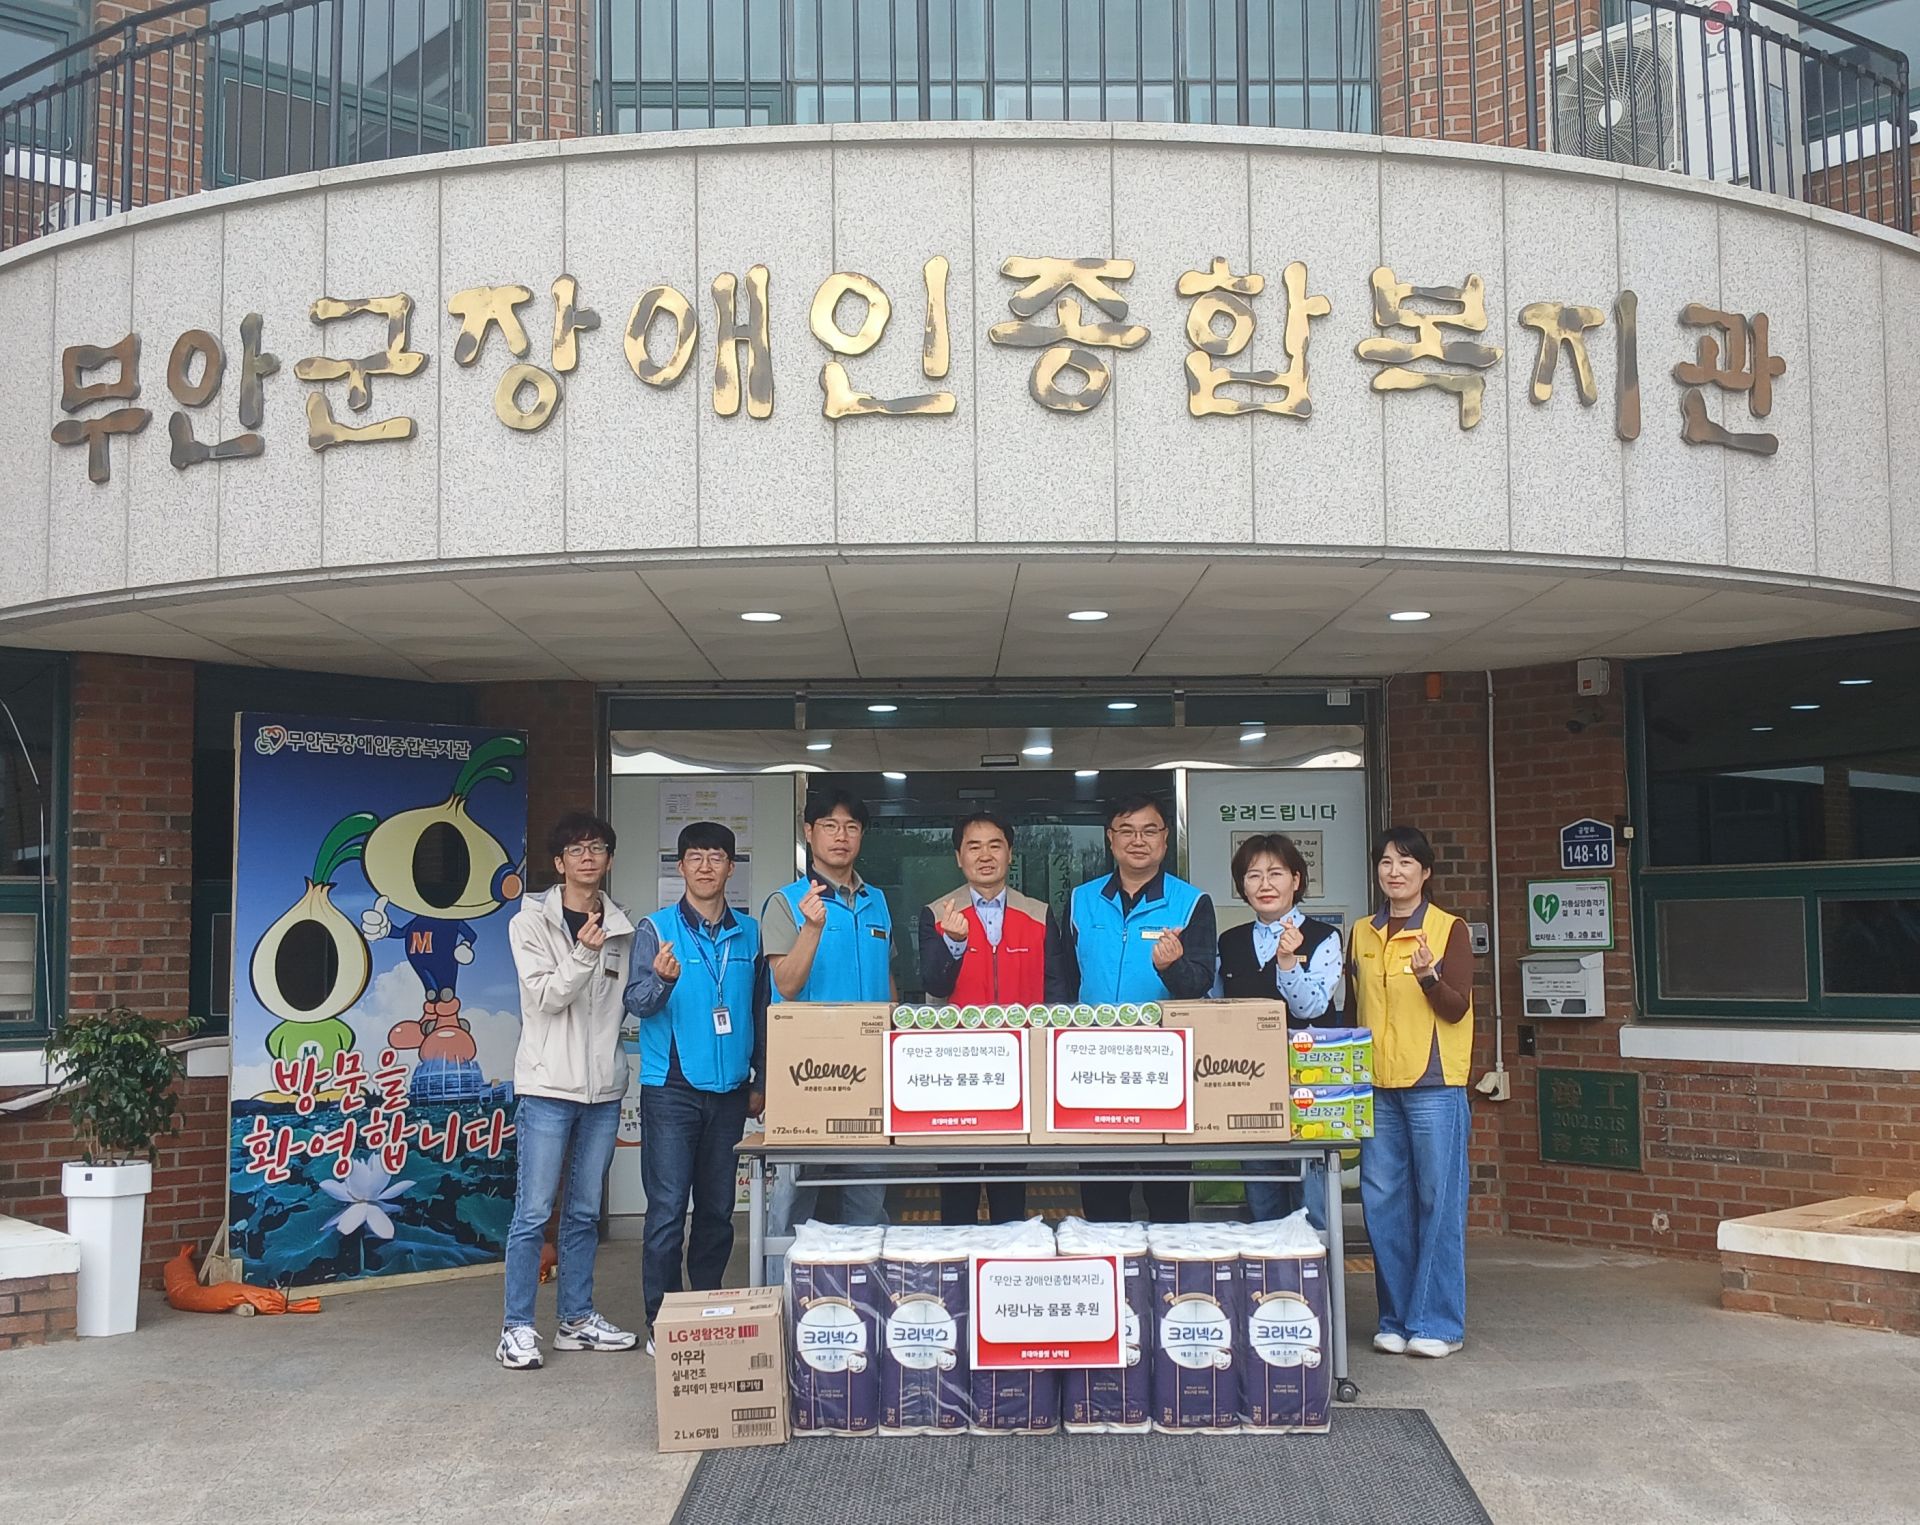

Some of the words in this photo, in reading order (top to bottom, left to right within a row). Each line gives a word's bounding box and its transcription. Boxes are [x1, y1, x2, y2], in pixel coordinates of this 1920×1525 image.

[286, 731, 471, 760] 무안군장애인종합복지관
[1219, 804, 1338, 822] 알려드립니다
[1567, 843, 1609, 863] 148-18
[410, 931, 433, 954] M
[275, 1047, 409, 1113] 방문을
[789, 1058, 866, 1086] Kleenex
[907, 1074, 953, 1087] 사랑나눔
[956, 1073, 980, 1086] 물품
[982, 1072, 1005, 1085] 후원
[1071, 1071, 1117, 1084] 사랑나눔
[1119, 1071, 1143, 1084] 물품
[1146, 1071, 1169, 1084] 후원
[242, 1108, 516, 1184] 환영합니다
[995, 1303, 1044, 1318] 사랑나눔
[1047, 1302, 1072, 1317] 물품
[1075, 1302, 1100, 1317] 후원
[668, 1329, 688, 1343] LG
[689, 1326, 736, 1341] 생활건강
[803, 1331, 858, 1345] 크리넥스
[892, 1328, 949, 1342] 크리넥스
[1168, 1327, 1223, 1341] 크리넥스
[1256, 1326, 1313, 1340] 크리넥스
[671, 1349, 705, 1366] 아우라
[672, 1368, 707, 1381] 실내건조
[672, 1383, 707, 1397] 홀리데이
[709, 1381, 737, 1393] 판타지
